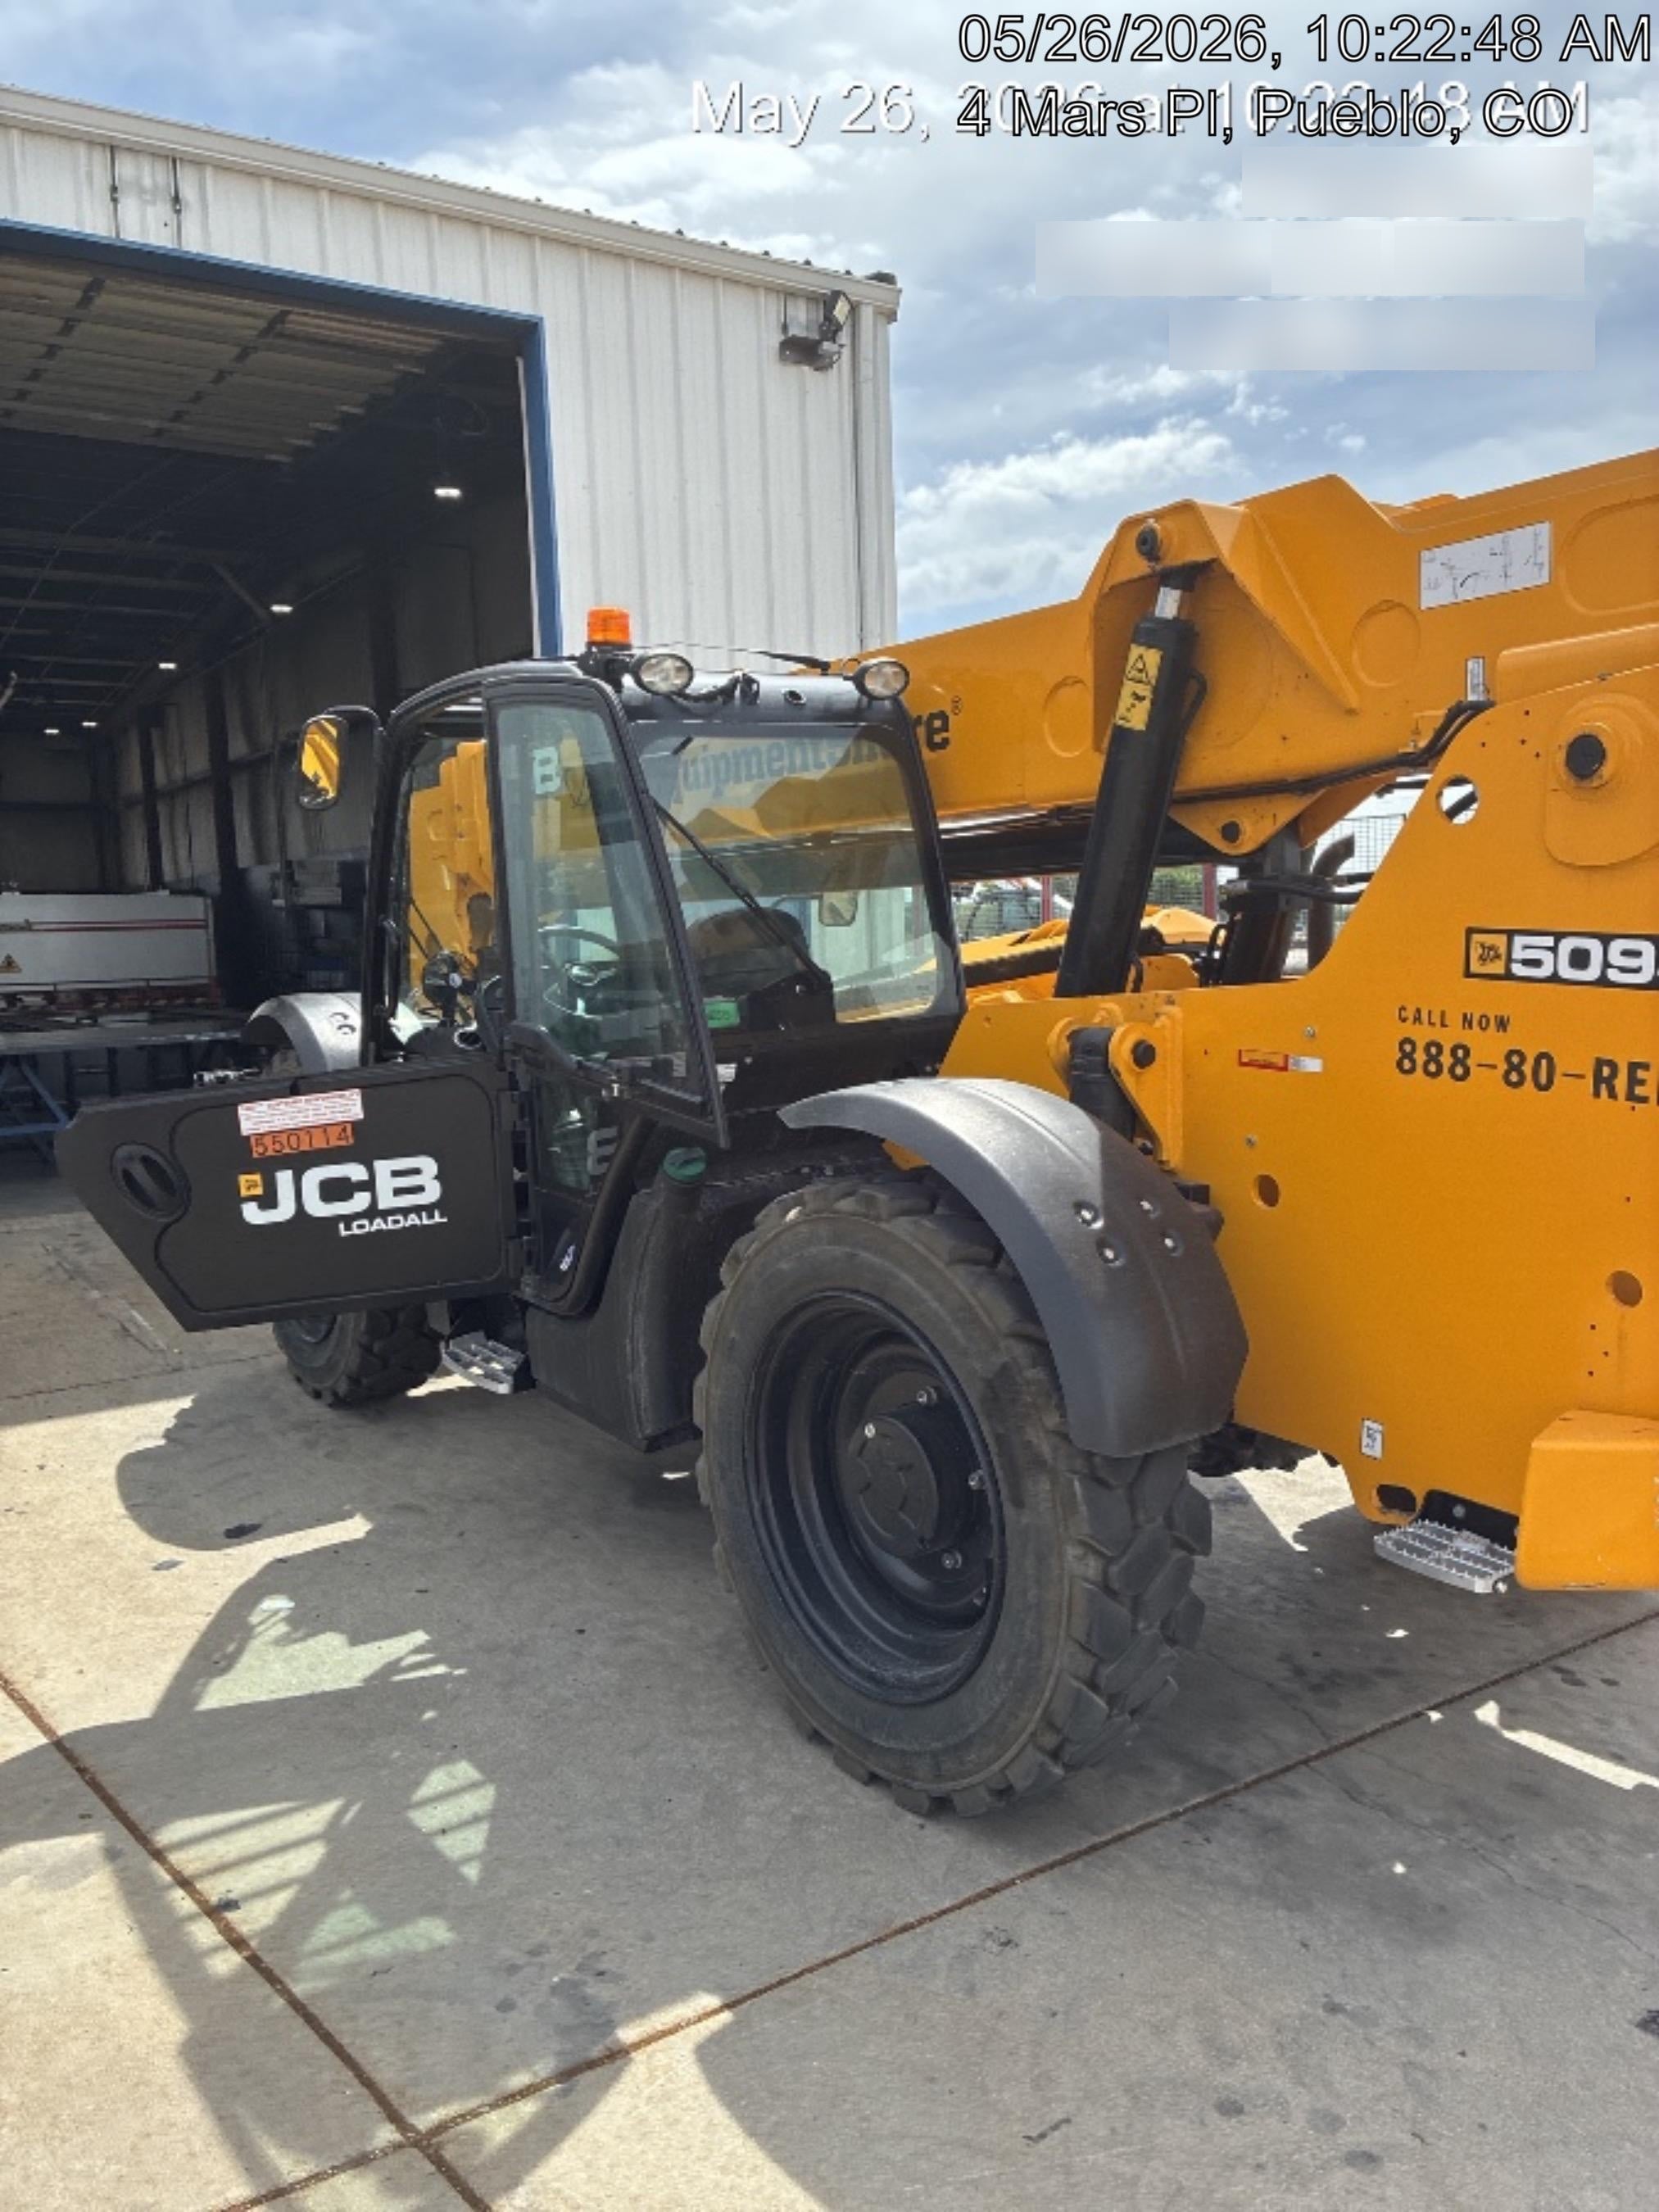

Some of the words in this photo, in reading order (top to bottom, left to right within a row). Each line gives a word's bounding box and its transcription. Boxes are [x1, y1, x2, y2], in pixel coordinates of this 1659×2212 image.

[1510, 935, 1659, 984] 509
[1398, 1004, 1449, 1028] CALL
[1462, 1012, 1511, 1033] NOW
[1395, 1036, 1659, 1107] 888-80-RE
[254, 1123, 350, 1157] 550114
[240, 1154, 442, 1226] JCB
[338, 1208, 448, 1237] LOADALL
